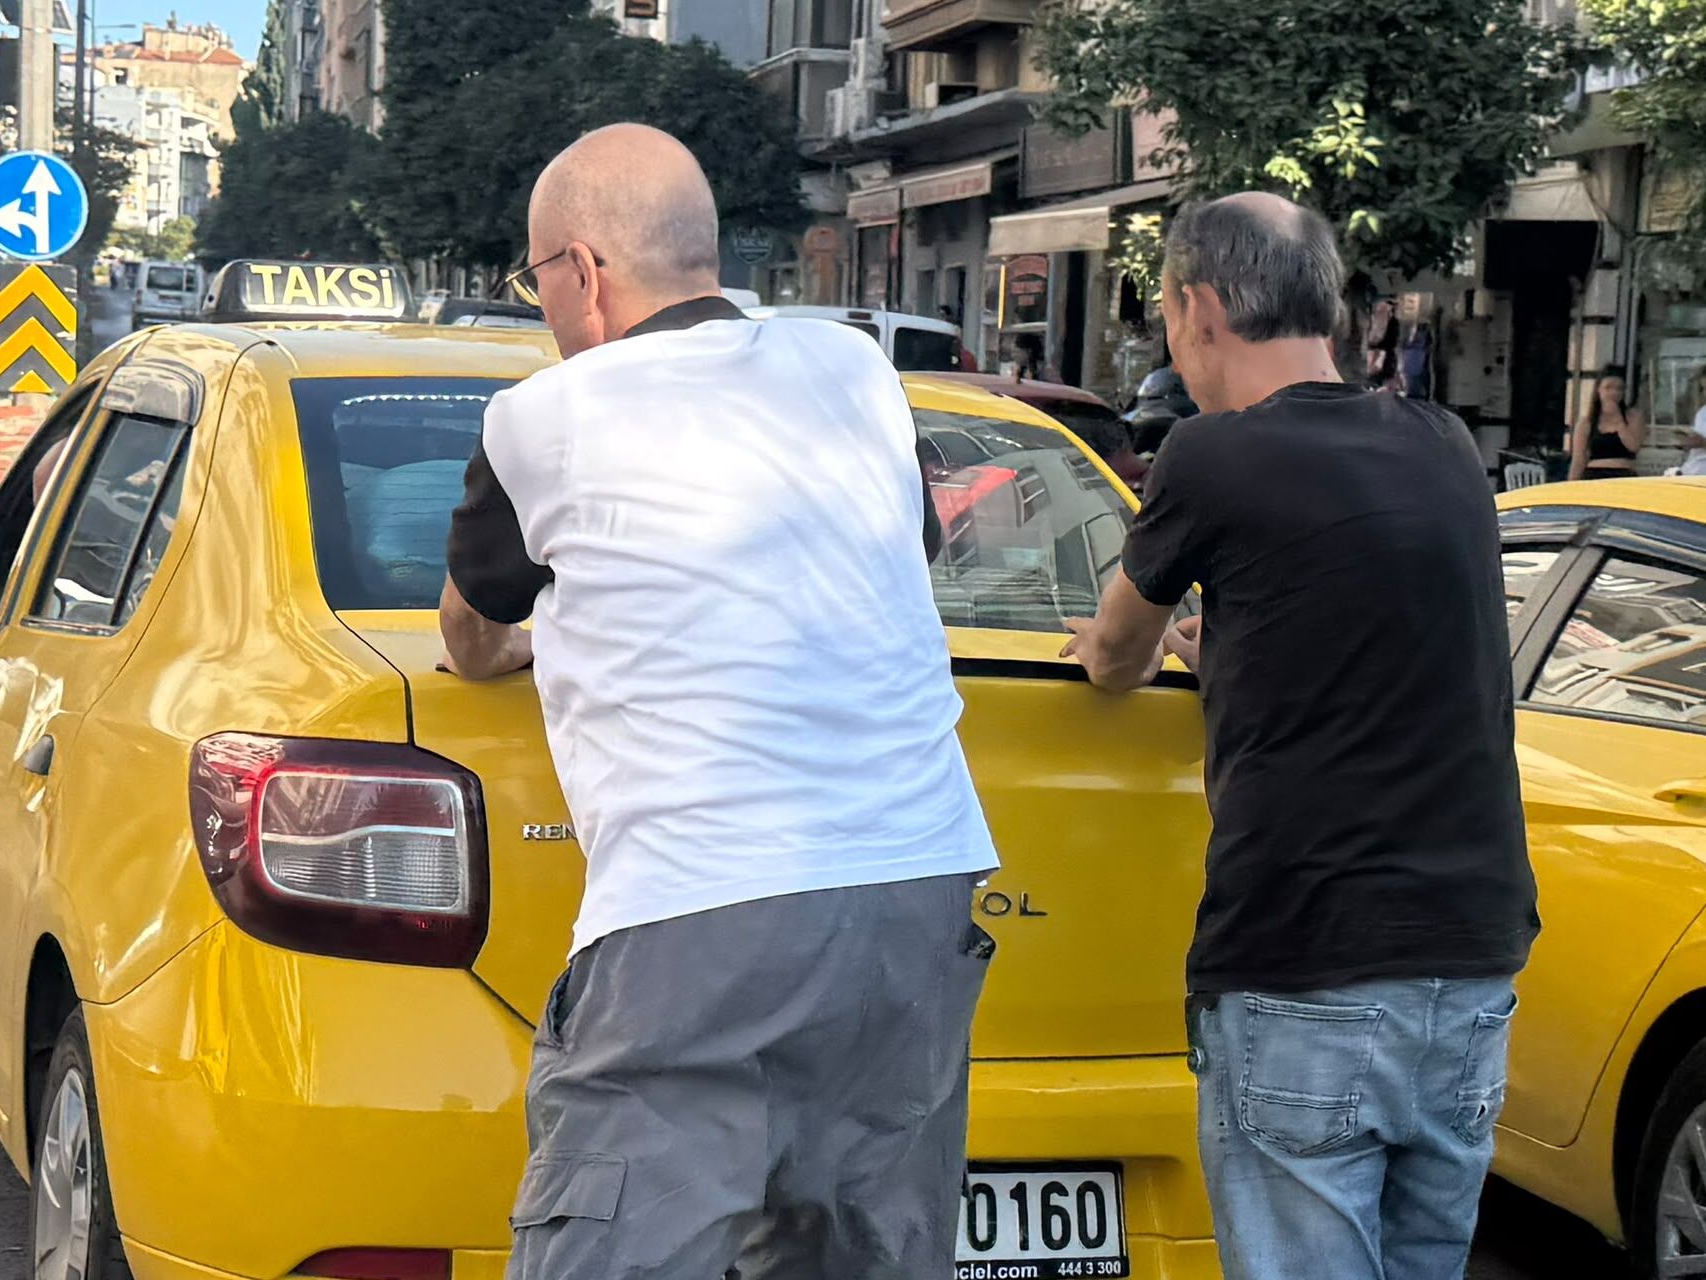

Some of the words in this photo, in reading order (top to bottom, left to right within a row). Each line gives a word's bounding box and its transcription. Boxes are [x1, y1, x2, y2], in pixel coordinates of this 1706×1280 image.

[523, 823, 577, 841] REN
[980, 891, 1048, 918] OL
[966, 1180, 1108, 1252] 0160
[954, 1262, 1038, 1280] ciel.com
[1058, 1261, 1083, 1276] 444
[1086, 1261, 1094, 1276] 3
[1097, 1260, 1122, 1275] 300
